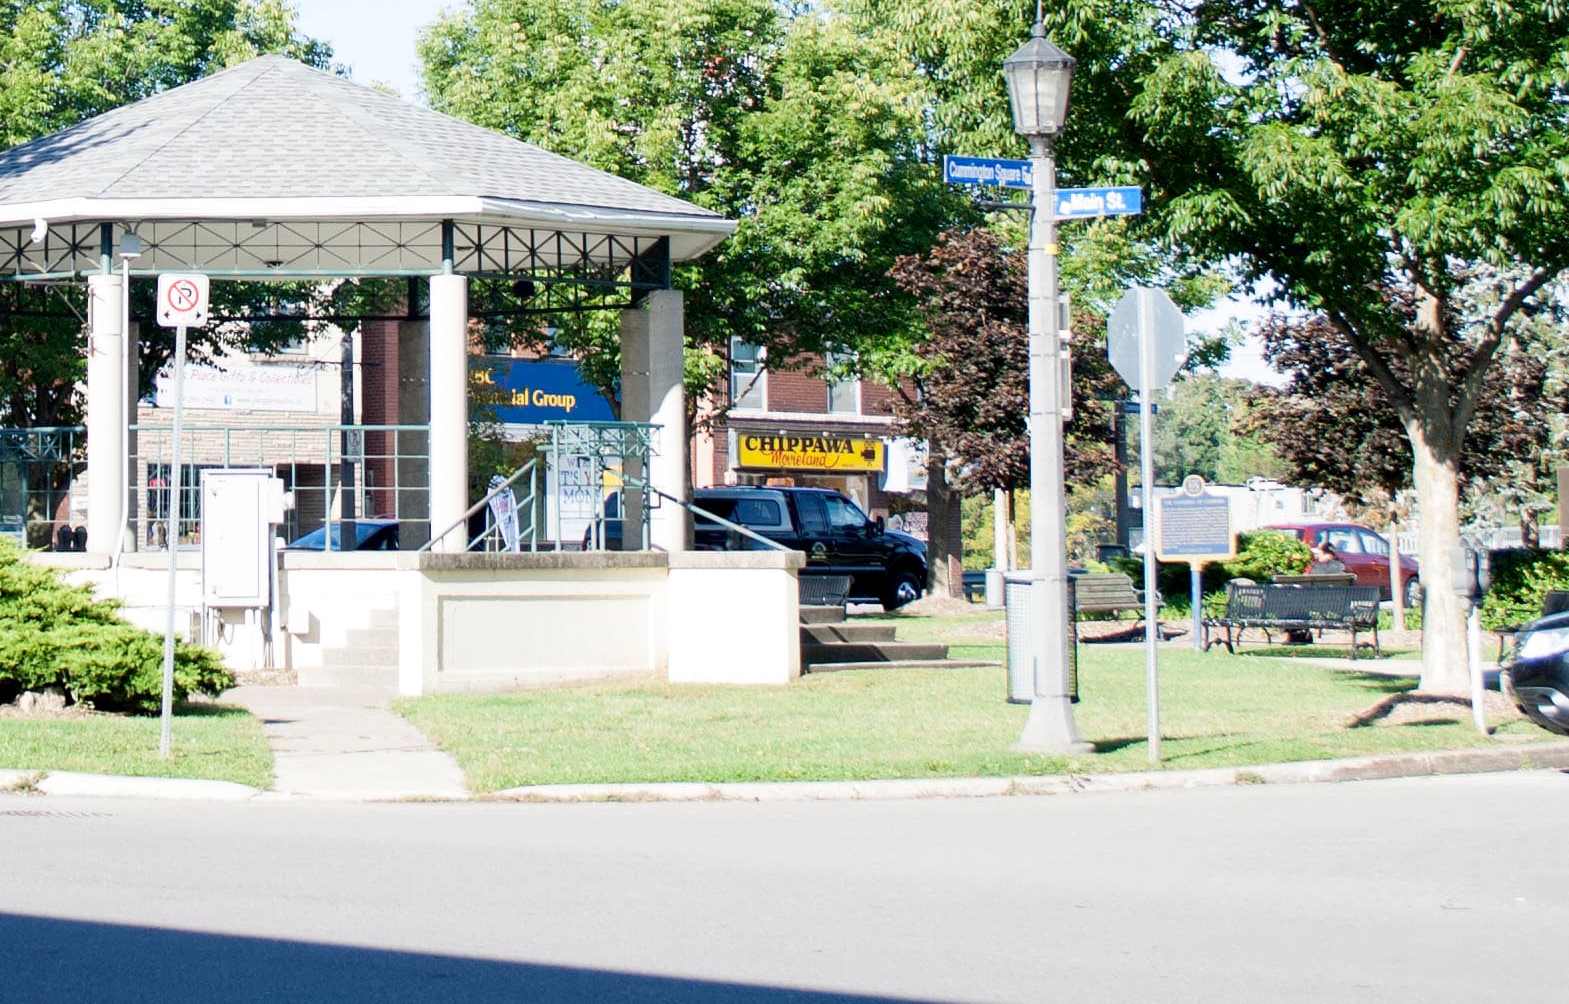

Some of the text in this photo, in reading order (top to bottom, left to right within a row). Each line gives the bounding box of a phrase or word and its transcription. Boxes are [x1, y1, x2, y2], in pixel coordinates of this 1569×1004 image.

[995, 163, 1020, 187] Square
[1071, 191, 1126, 210] Main St.
[533, 389, 576, 412] Group
[745, 435, 855, 454] CHIPPAWA
[766, 450, 839, 468] Movieland
